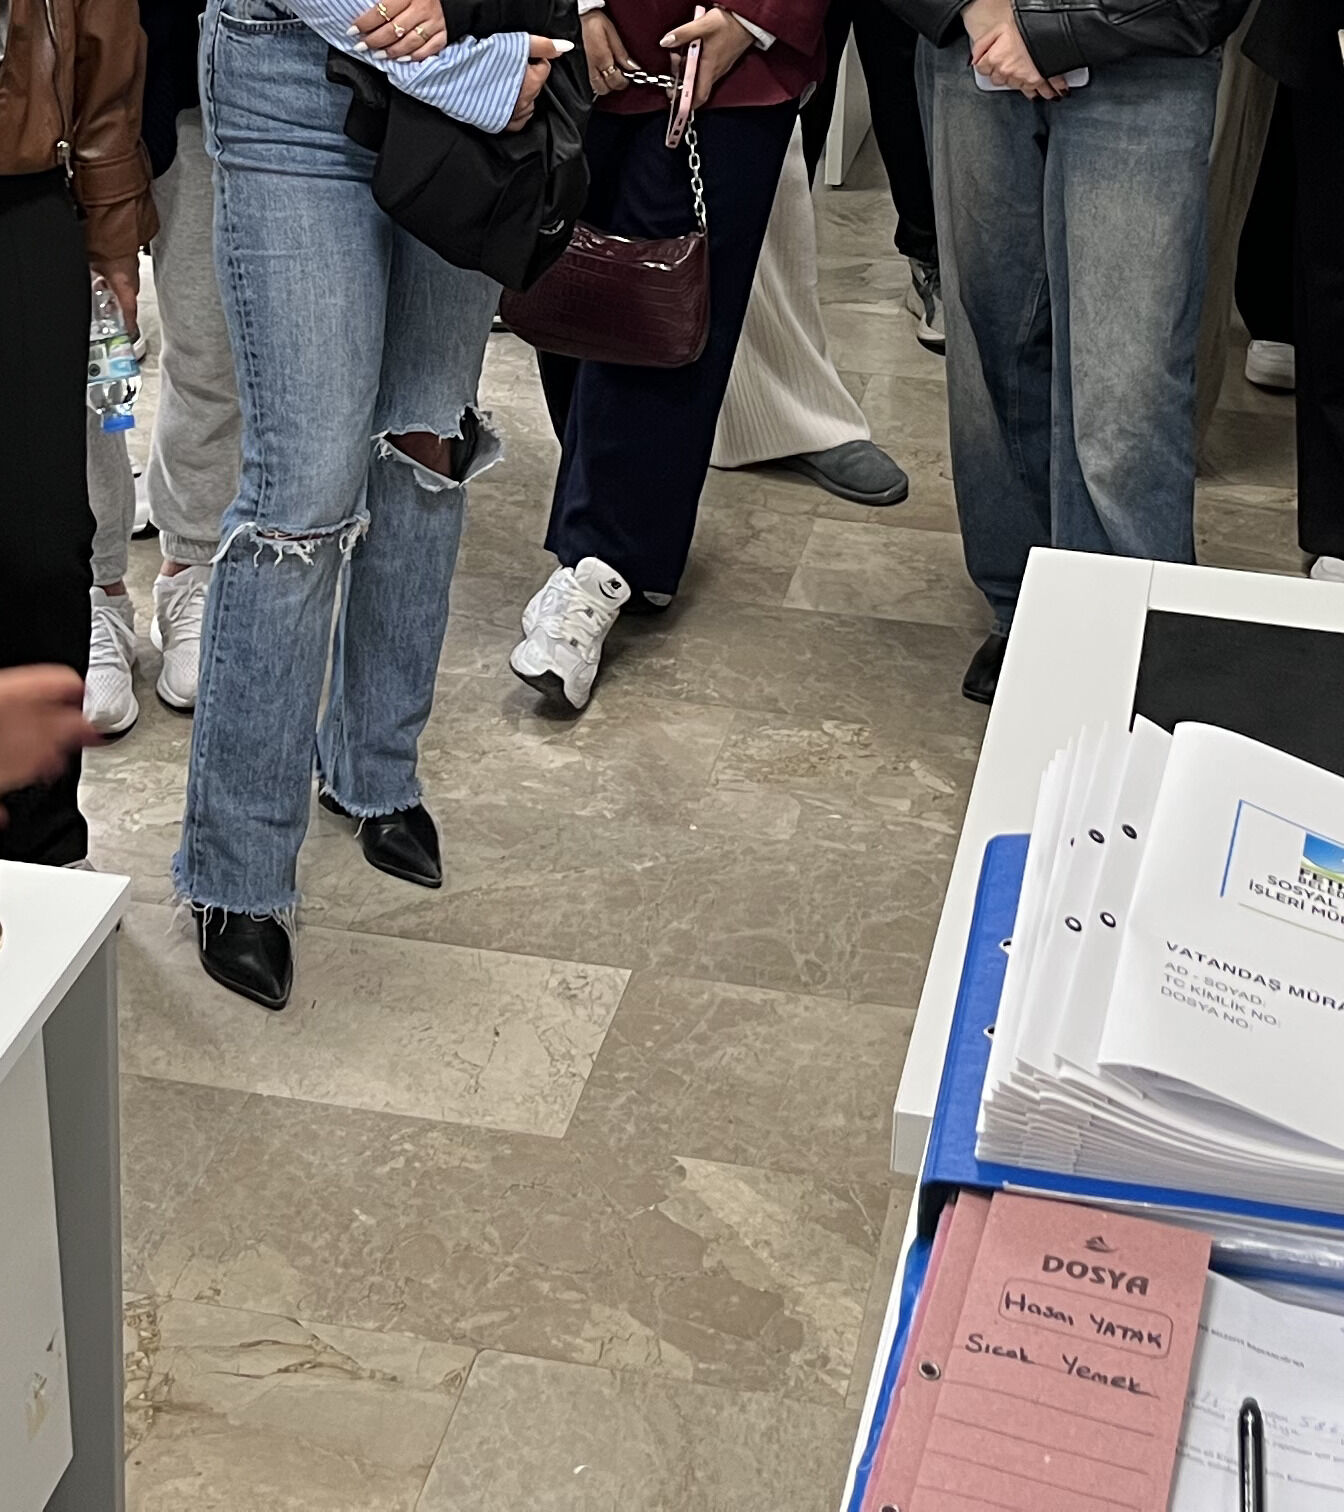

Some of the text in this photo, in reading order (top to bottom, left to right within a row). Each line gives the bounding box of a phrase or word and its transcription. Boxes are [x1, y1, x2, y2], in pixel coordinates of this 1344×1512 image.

[1249, 878, 1305, 910] İŞLERİ
[1267, 875, 1339, 909] SOSYAL
[1164, 974, 1186, 988] TC
[1166, 940, 1282, 992] VATANDAŞ
[1160, 986, 1219, 1018] DOSYA
[1041, 1254, 1150, 1296] DOSYA
[1089, 1313, 1162, 1349] YATAK
[1062, 1354, 1150, 1398] Yemek
